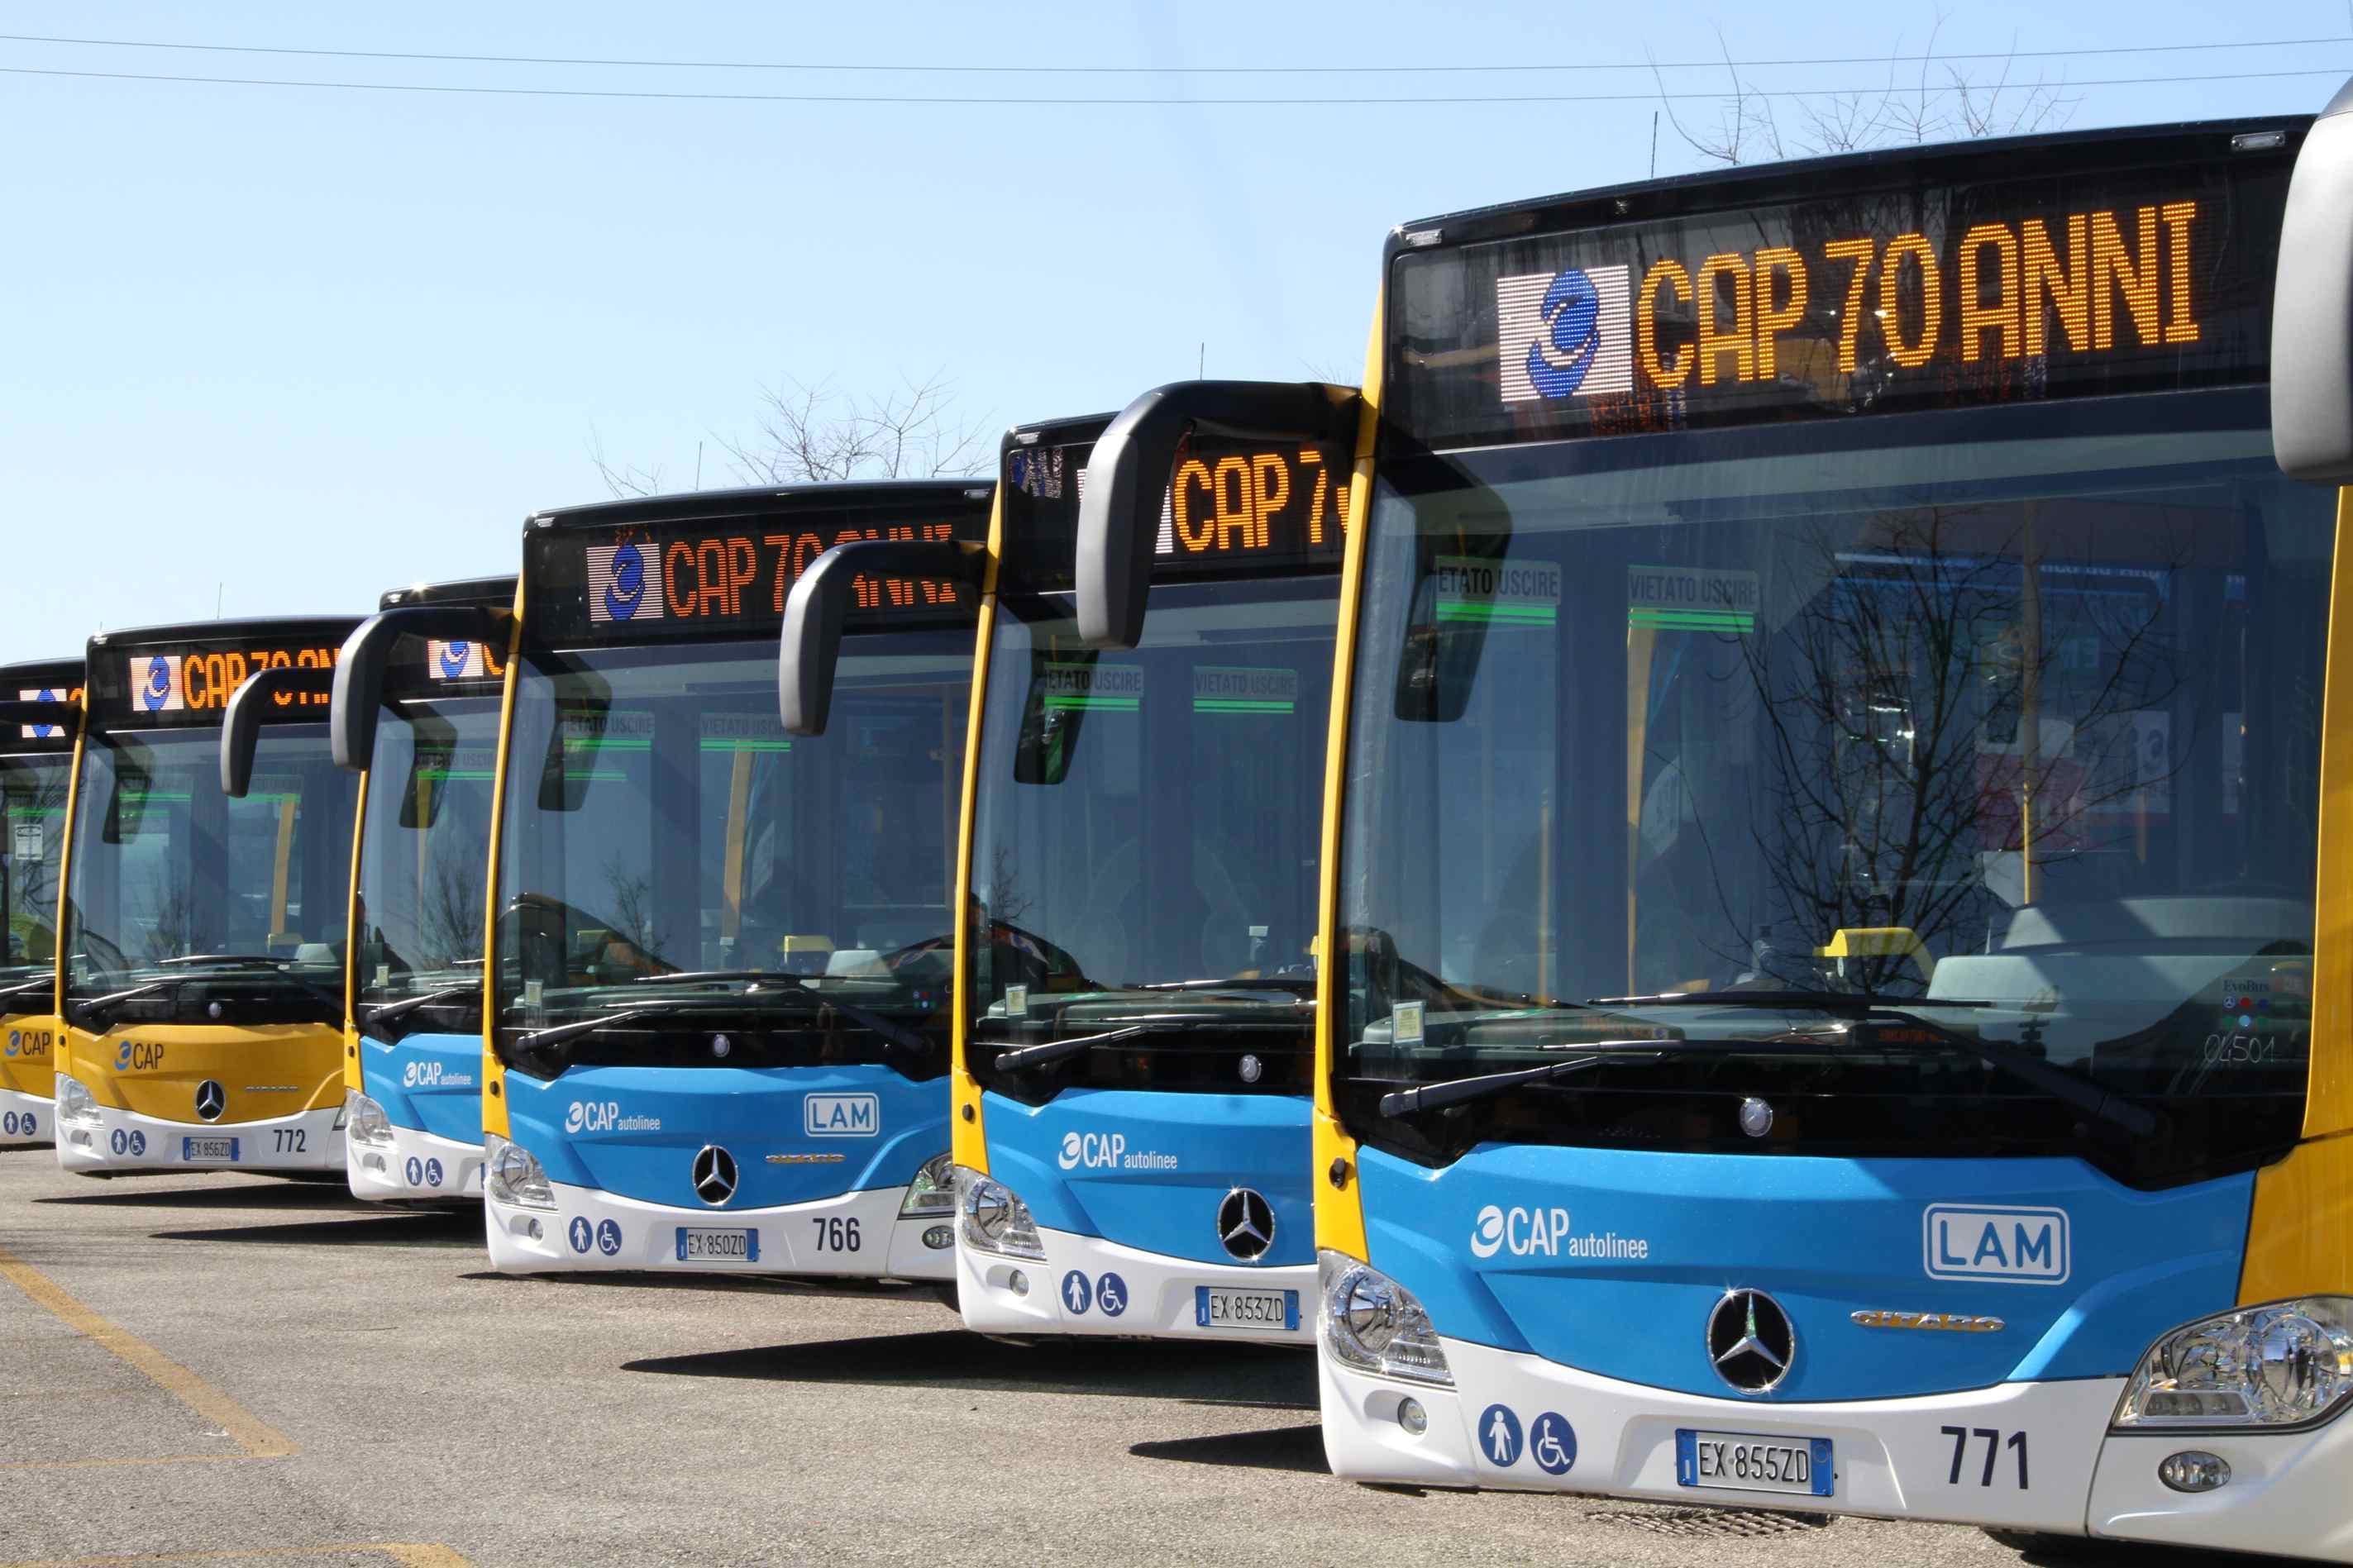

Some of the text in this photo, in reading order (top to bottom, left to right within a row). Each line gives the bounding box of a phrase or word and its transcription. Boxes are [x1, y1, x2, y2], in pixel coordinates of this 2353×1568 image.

[1637, 202, 2198, 388] CAP 70 ANNI
[1175, 455, 1289, 551] CAP
[666, 537, 756, 617] CAP
[1439, 566, 1558, 597] ETATO USCIRE
[1629, 574, 1758, 605] VIETATO USCIRE
[184, 652, 247, 709] CAP
[1045, 670, 1141, 692] IETATO USCIRE
[22, 1032, 50, 1056] CAP
[133, 1043, 164, 1070] CAP
[418, 1061, 442, 1085] CAP
[585, 1102, 661, 1132] CAP autolinee
[813, 1102, 870, 1128] LAM
[273, 1129, 307, 1152] 772
[1083, 1133, 1177, 1169] CAP autolinee
[688, 1234, 746, 1256] EX 850ZD
[813, 1218, 861, 1252] 766
[1507, 1206, 1648, 1259] CAP autolinee
[1940, 1219, 2051, 1270] LAM
[1210, 1295, 1229, 1319] EX
[1699, 1442, 1809, 1483] EX 855ZD
[1940, 1425, 2029, 1490] 771
